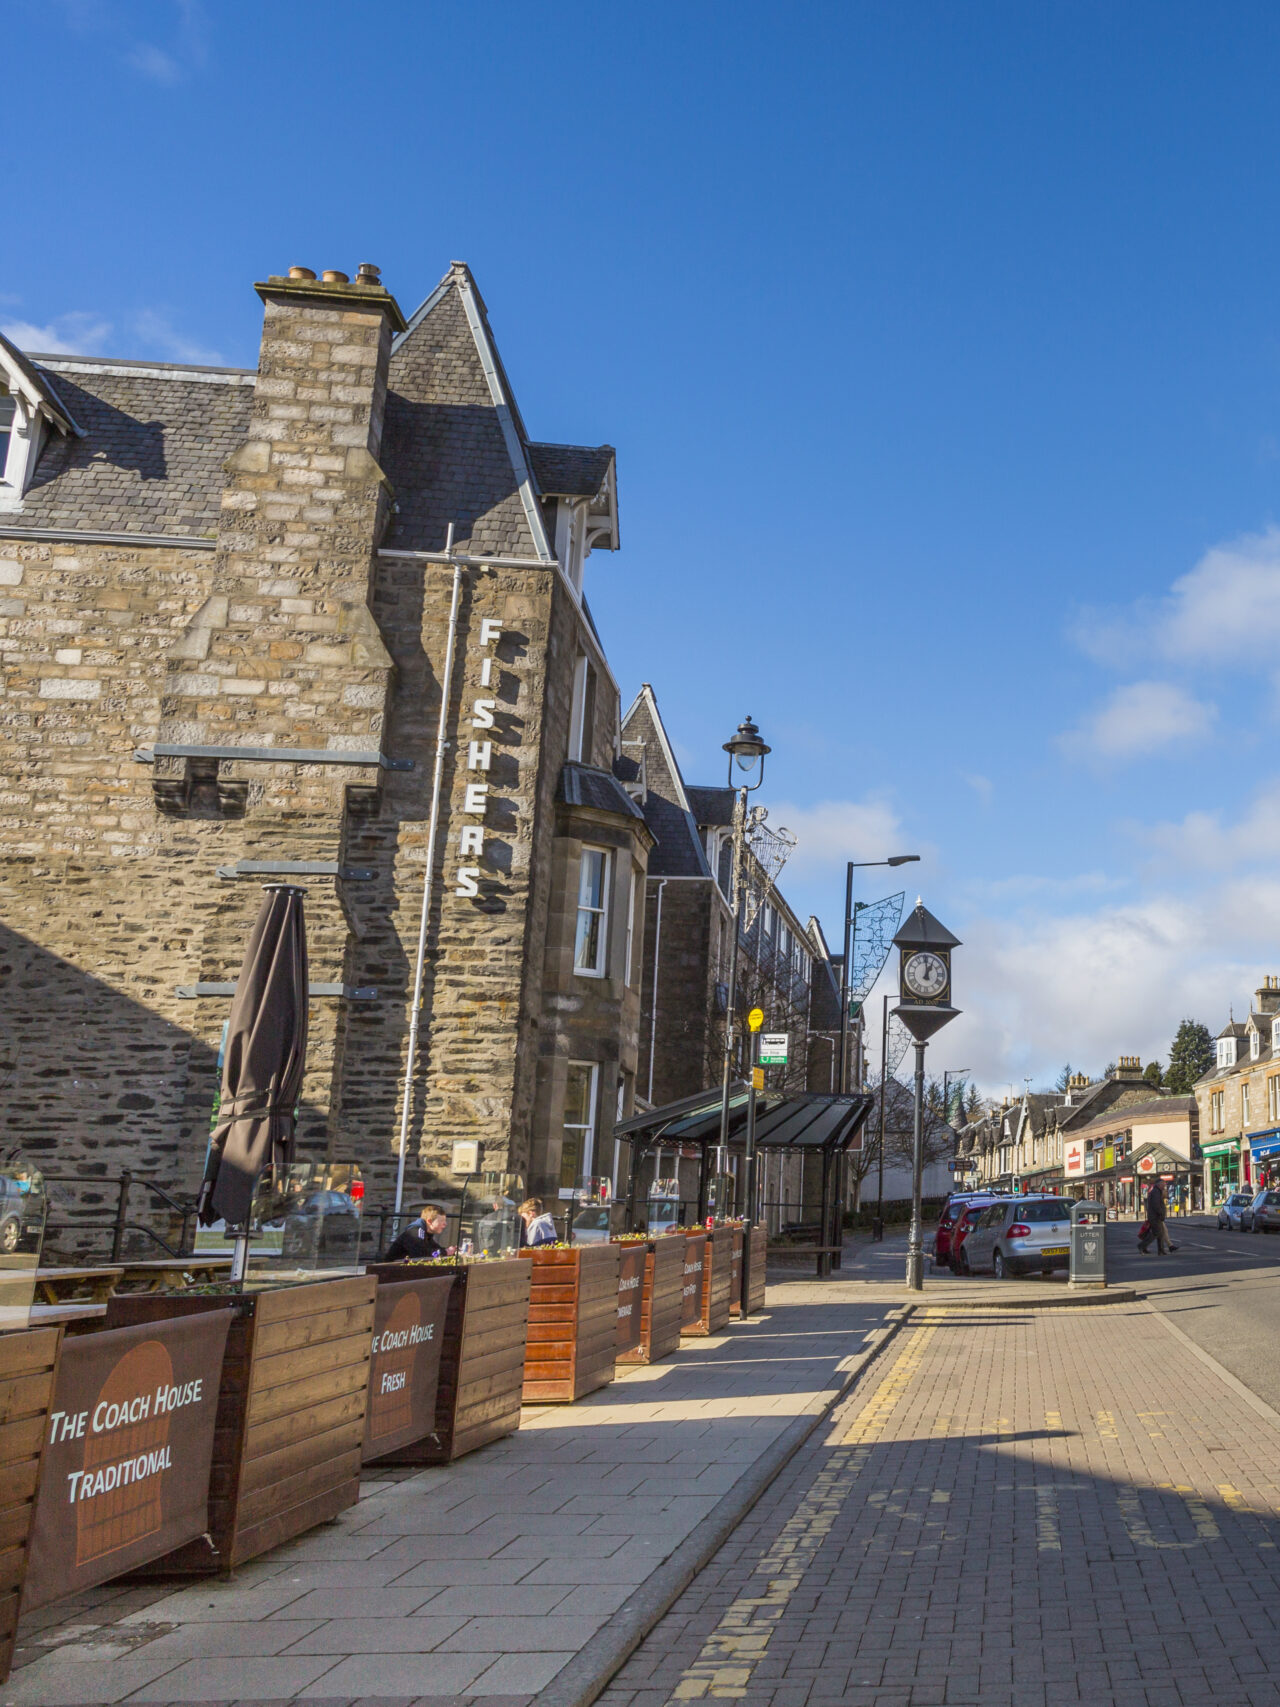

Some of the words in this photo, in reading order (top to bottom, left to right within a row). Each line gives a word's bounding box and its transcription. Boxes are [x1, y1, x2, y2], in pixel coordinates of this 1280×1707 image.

[456, 618, 503, 898] FISHERS
[381, 1329, 409, 1352] COACH
[409, 1323, 434, 1345] HOUSE
[50, 1411, 88, 1445] THE
[92, 1394, 151, 1433] COACH
[153, 1378, 203, 1416] HOUSE
[380, 1371, 406, 1395] FRESH
[67, 1445, 172, 1504] TRADITIONAL
